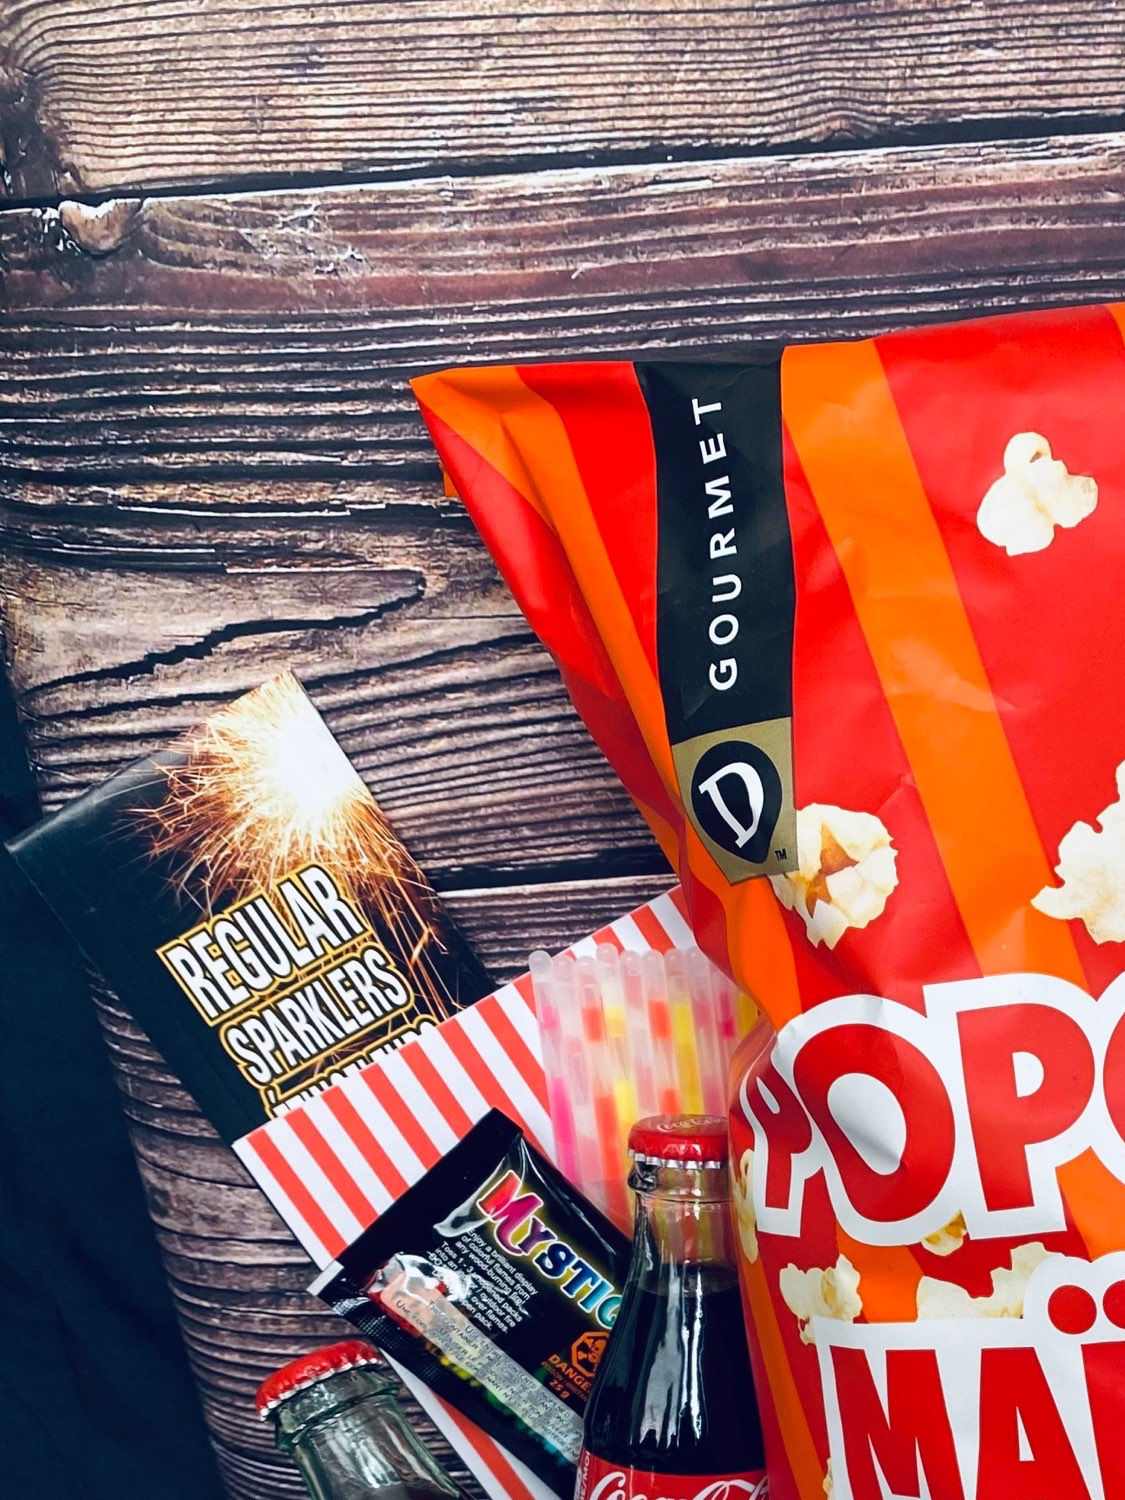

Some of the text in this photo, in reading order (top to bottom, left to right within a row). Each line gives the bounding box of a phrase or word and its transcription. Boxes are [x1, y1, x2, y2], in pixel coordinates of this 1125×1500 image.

[691, 397, 744, 692] GOURMET
[166, 868, 365, 1018] REGULAR
[227, 948, 408, 1084] SPARKLERS
[439, 1240, 523, 1323] Toss packs
[492, 1262, 516, 1286] flames
[513, 1282, 531, 1300] from
[512, 1270, 539, 1297] display
[548, 1354, 593, 1391] DANGE
